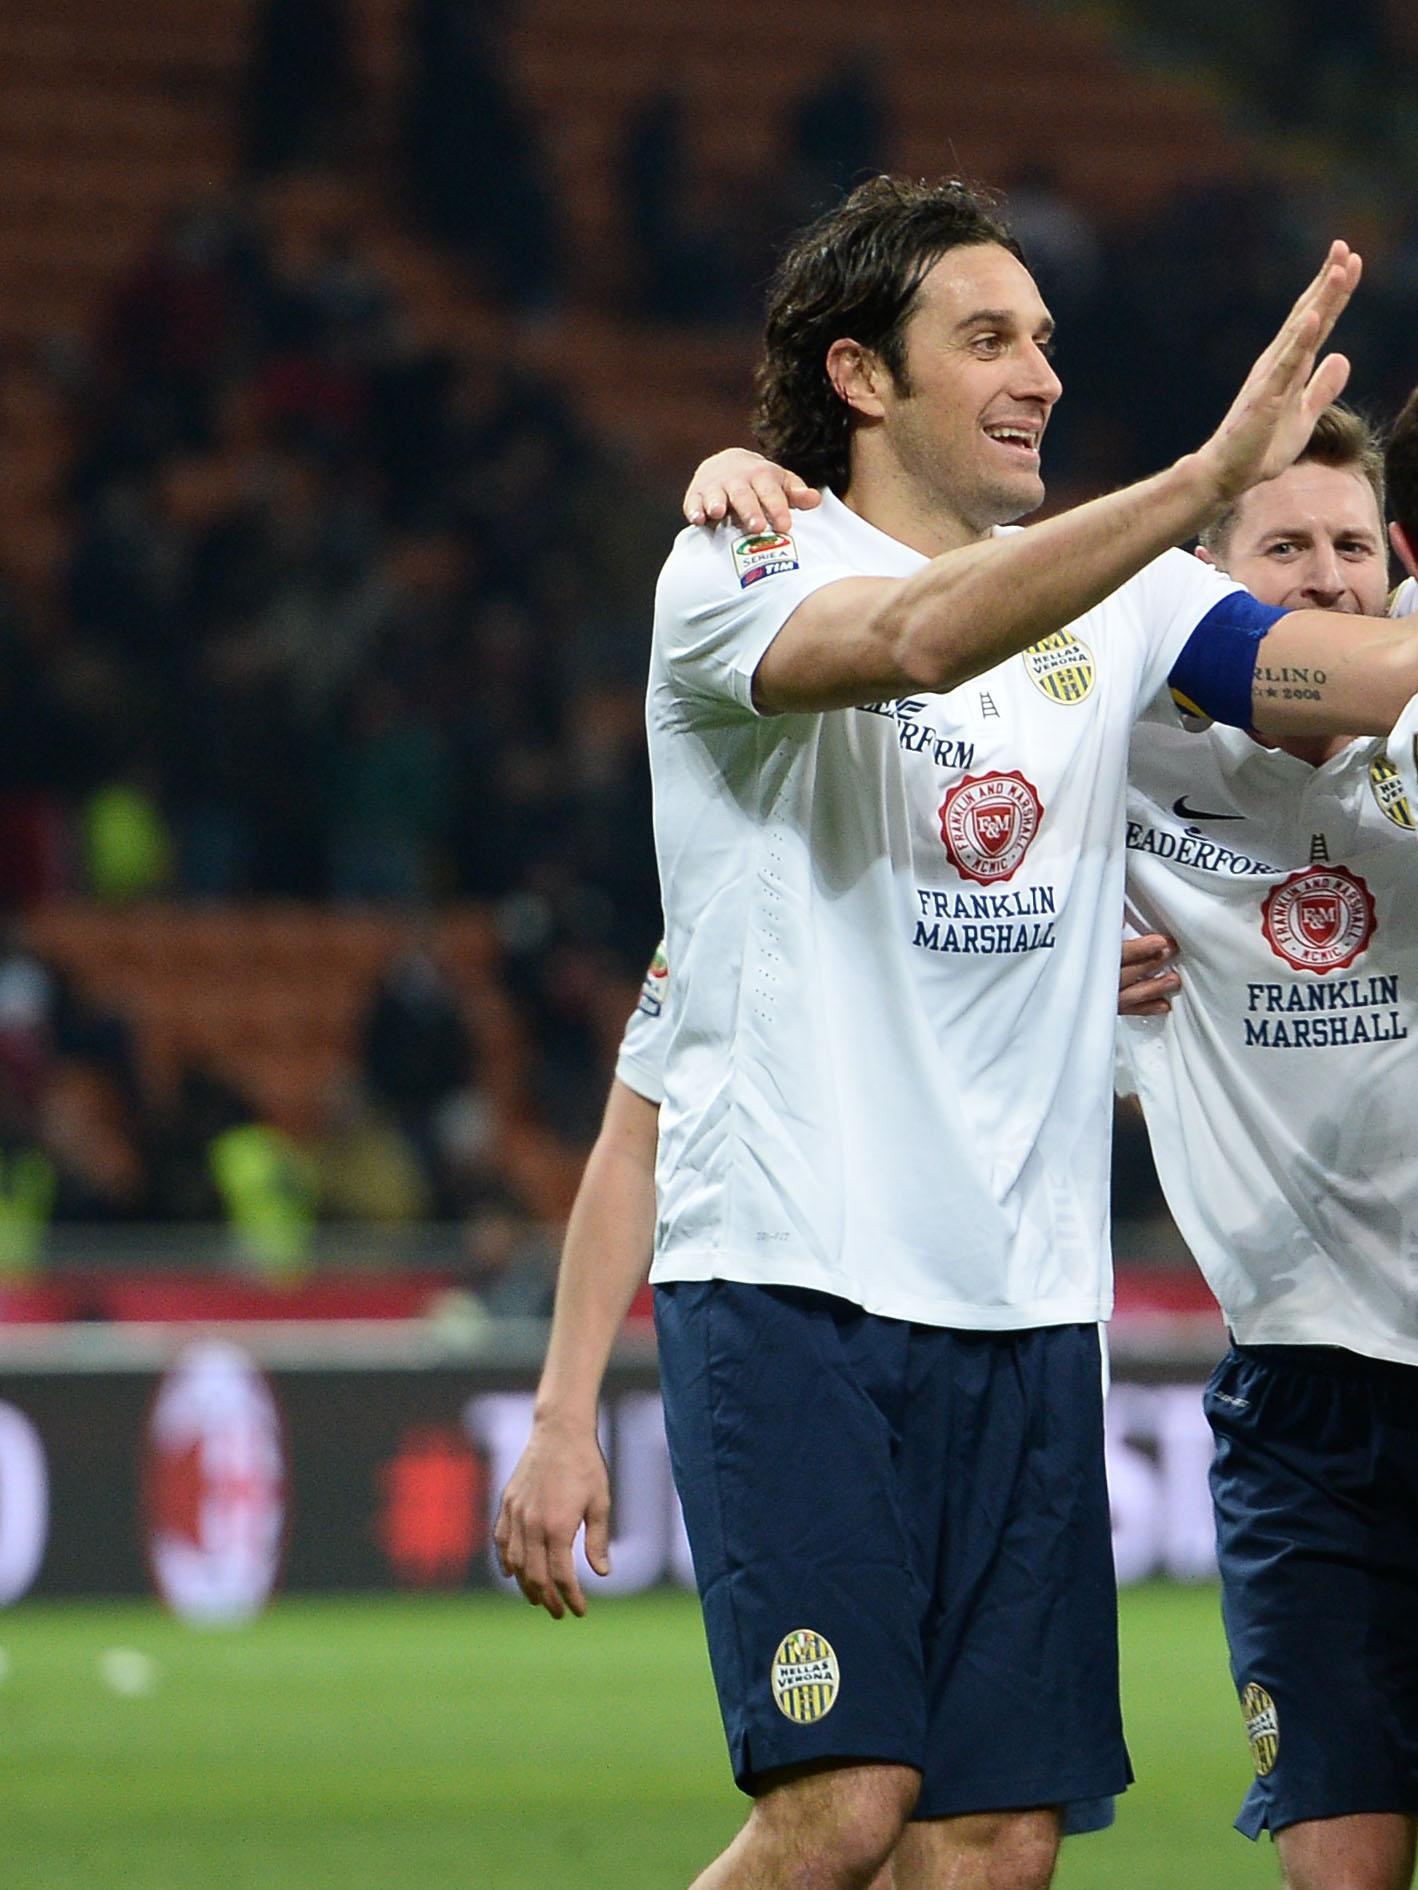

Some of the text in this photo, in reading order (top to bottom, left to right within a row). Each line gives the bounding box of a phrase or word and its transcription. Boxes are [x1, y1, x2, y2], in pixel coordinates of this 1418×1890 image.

[765, 561, 794, 575] TIM
[1032, 645, 1080, 665] HELLAS
[1033, 653, 1088, 674] VERONA
[979, 782, 1004, 798] AND
[916, 886, 1056, 919] FRANKLIN
[912, 921, 1056, 954] MARSHALL
[1247, 975, 1399, 1012] FRANKLIN
[1243, 1011, 1408, 1048] MARSHALL
[781, 1660, 829, 1676] HELLAS
[778, 1671, 833, 1688] VERONA
